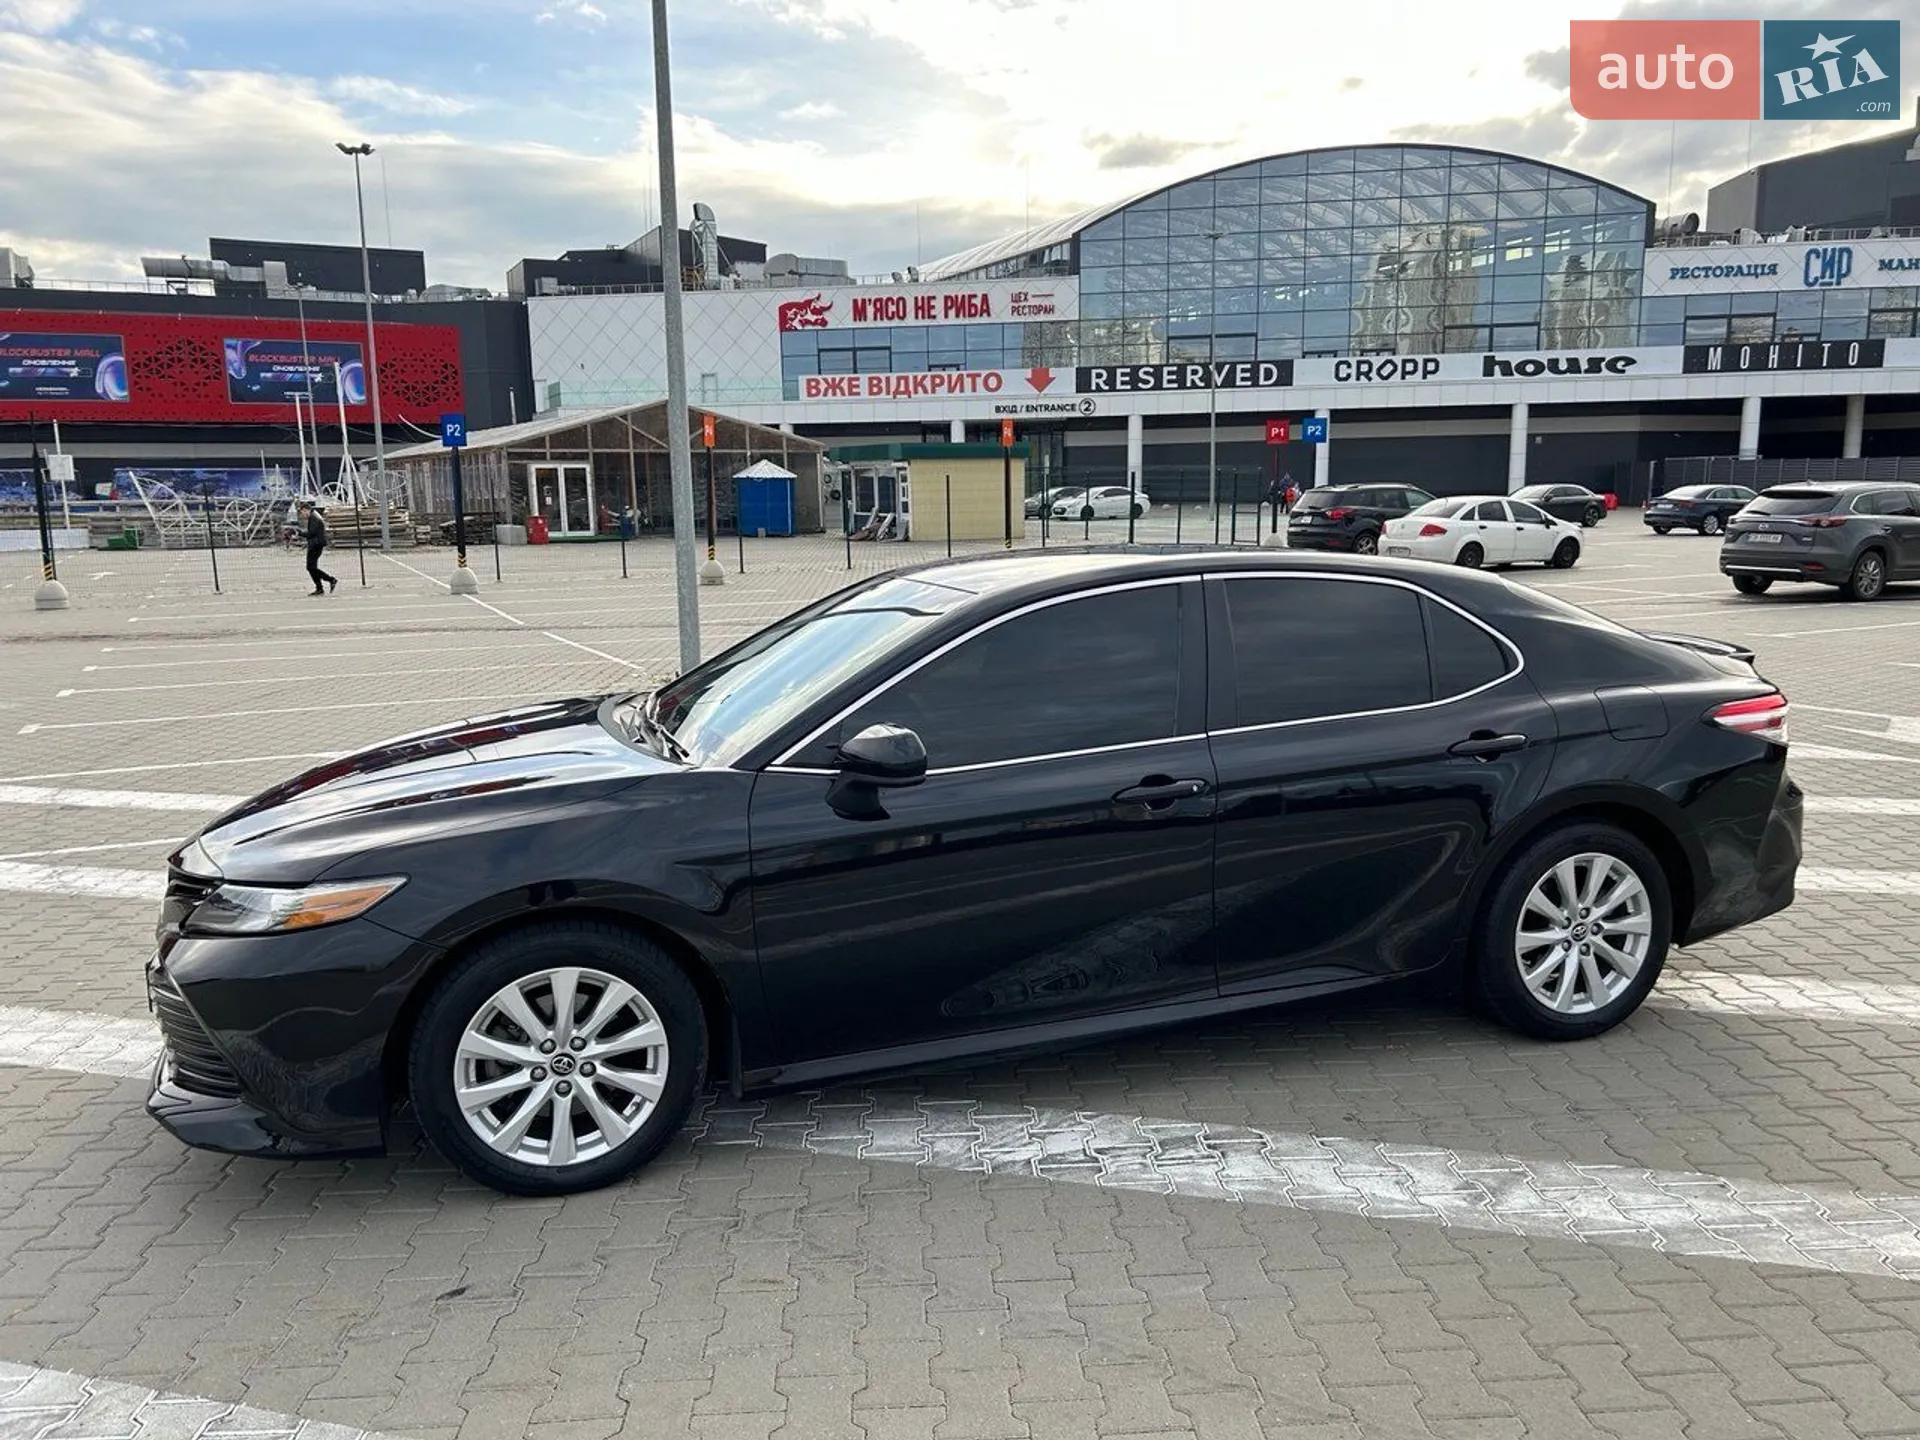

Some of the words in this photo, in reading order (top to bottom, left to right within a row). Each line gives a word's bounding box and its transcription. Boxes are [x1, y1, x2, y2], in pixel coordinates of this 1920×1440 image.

[1669, 262, 1779, 280] РЕСТОРАЦІЯ
[1803, 247, 1853, 287] СИР
[914, 295, 937, 320] НЕ
[943, 293, 991, 319] РИБА
[1010, 291, 1029, 303] ЦЕХ
[1010, 304, 1055, 316] РЕСТОРАН
[1482, 354, 1638, 378] house
[1707, 342, 1860, 371] MOHITO
[1090, 362, 1278, 391] RESERVED
[1334, 357, 1440, 382] CROPP
[805, 377, 861, 398] ВЖЕ
[867, 372, 1004, 399] ВІДКРИТО
[995, 405, 1017, 414] ВХІД
[1025, 403, 1077, 413] ENTRANCE
[446, 424, 461, 437] P2
[1271, 427, 1285, 438] P1
[1307, 425, 1322, 436] P2
